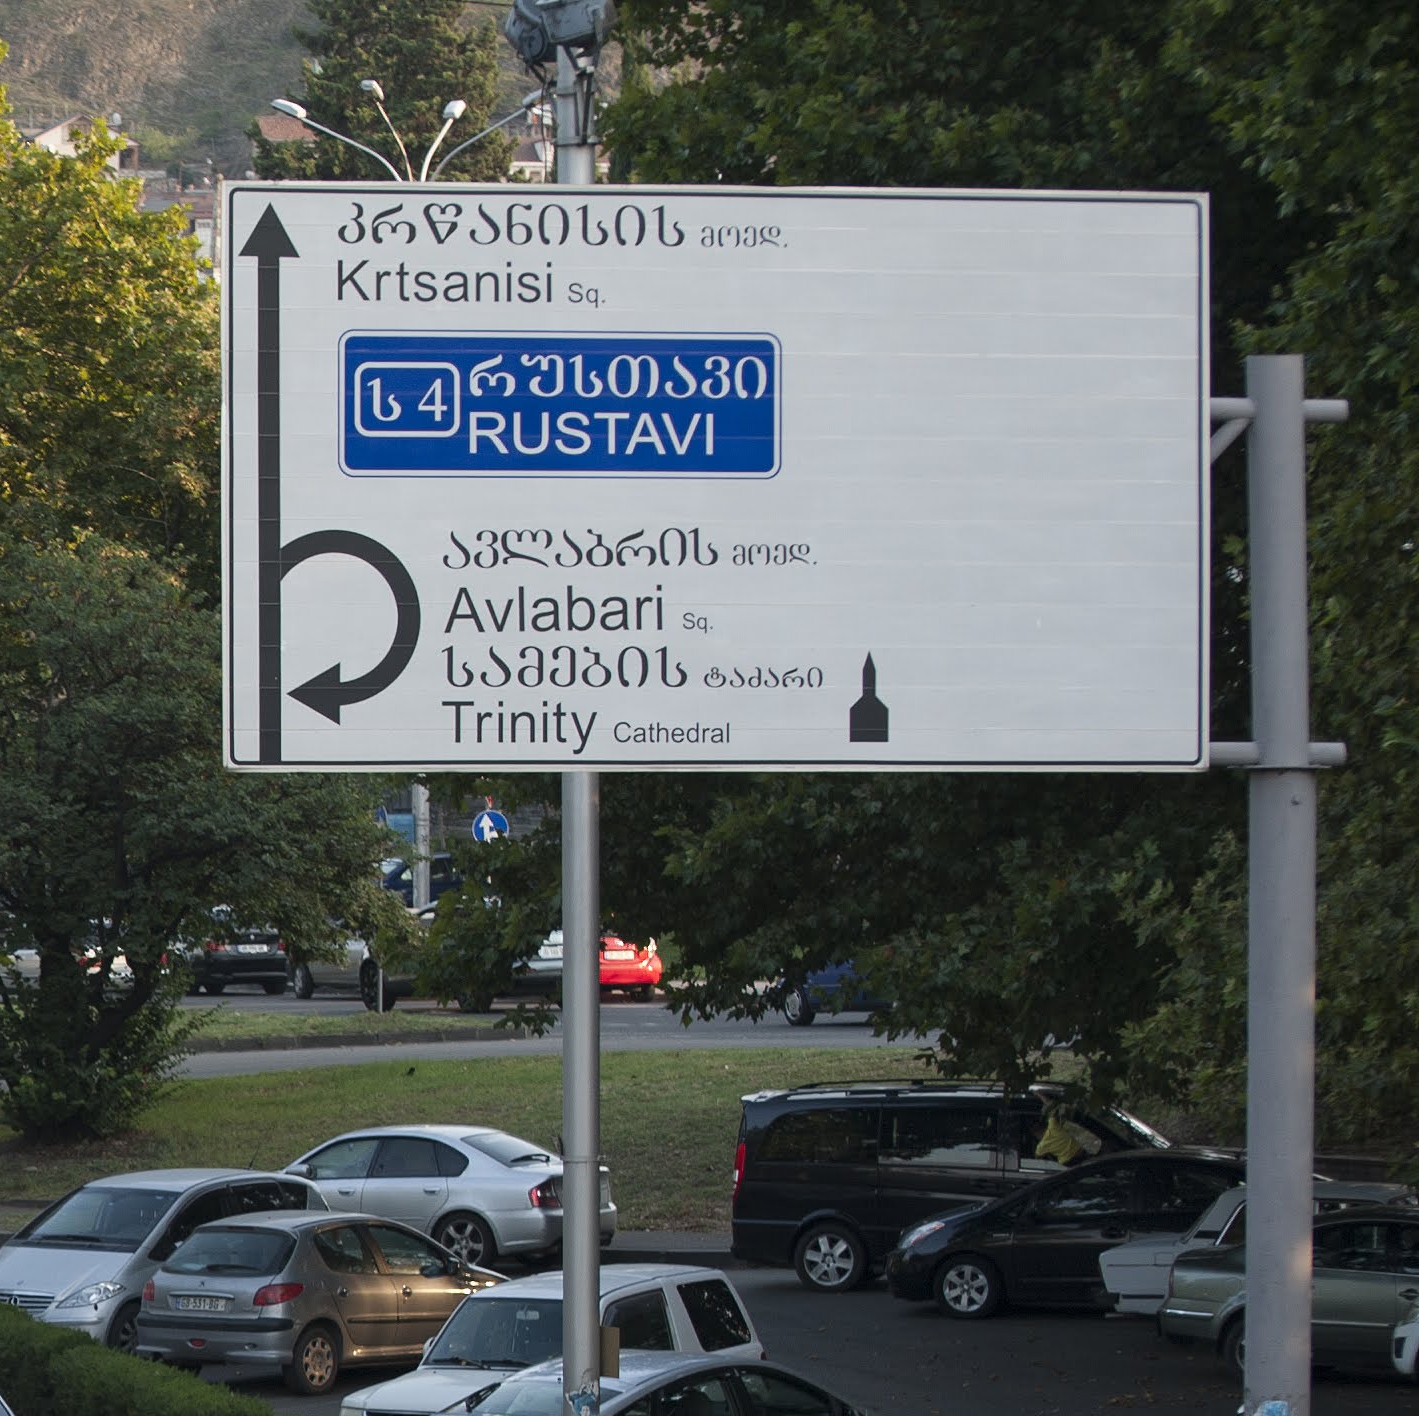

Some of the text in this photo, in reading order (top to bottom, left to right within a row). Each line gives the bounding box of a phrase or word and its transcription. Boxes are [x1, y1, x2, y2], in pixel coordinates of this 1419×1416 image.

[337, 202, 789, 248] კრწანისის მოედ.
[337, 259, 607, 309] Krtsanisi Sq.
[469, 353, 768, 400] რუსთავი
[366, 377, 448, 423] ს 4
[469, 411, 715, 456] RUSTAVI
[442, 527, 818, 570] ავლაბრის მოედ.
[444, 584, 715, 635] Avlabari Sq.
[441, 645, 824, 688] სამების ტაძარი
[441, 700, 731, 755] Trinity Cathedral
